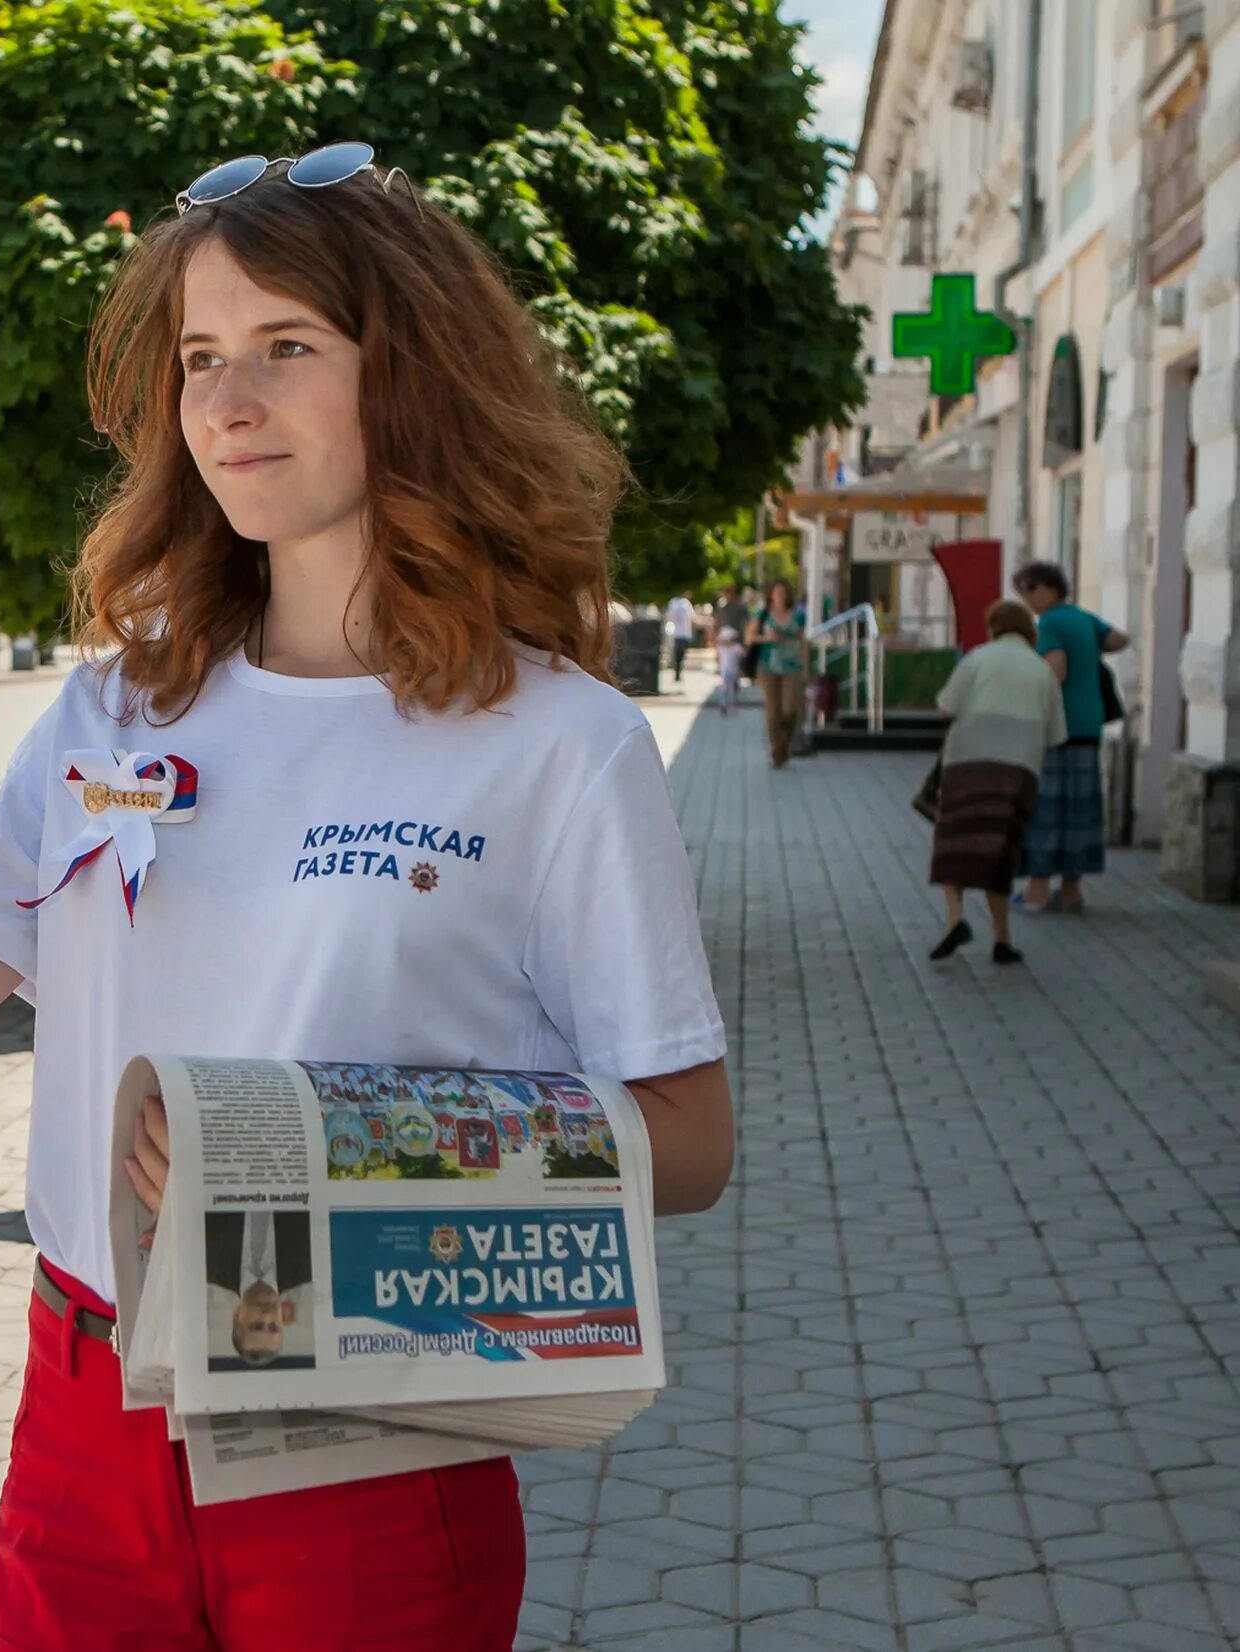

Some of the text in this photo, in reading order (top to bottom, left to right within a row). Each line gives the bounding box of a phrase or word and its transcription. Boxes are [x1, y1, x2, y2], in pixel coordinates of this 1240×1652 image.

[302, 820, 486, 862] КРЫМСКАЯ
[292, 850, 400, 883] ГАЗЕТА
[466, 1222, 620, 1262] ГАЗЕТА
[374, 1263, 626, 1308] КРЫМСКАЯ
[338, 1323, 638, 1360] Поздравляем с Днём России!
